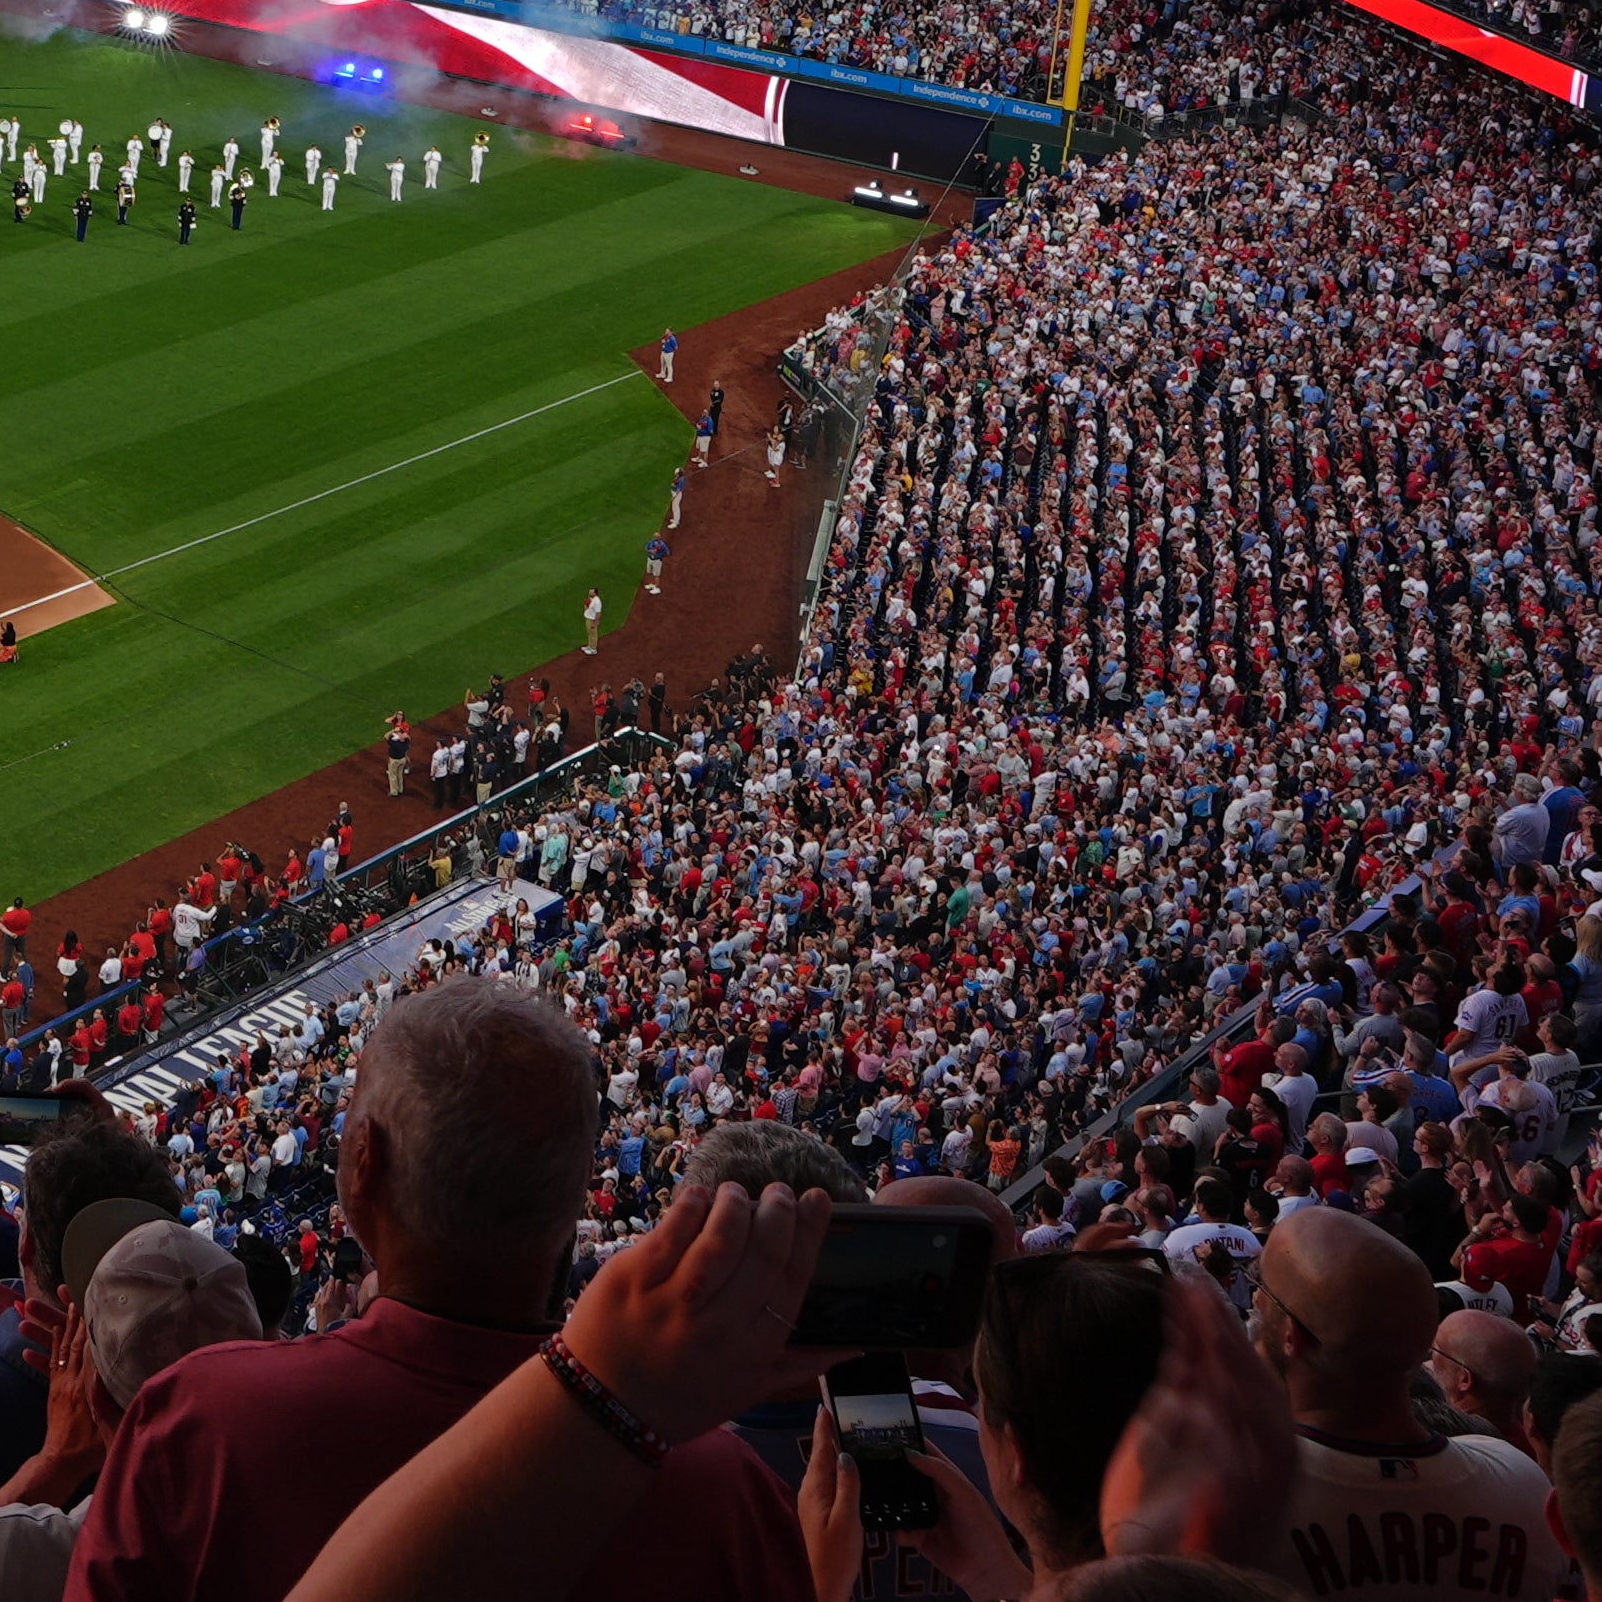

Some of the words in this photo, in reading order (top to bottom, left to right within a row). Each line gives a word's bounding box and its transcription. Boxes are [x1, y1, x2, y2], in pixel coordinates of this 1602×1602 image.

[640, 31, 674, 46] ibx.com
[716, 44, 776, 66] Independence
[830, 68, 868, 85] ibx.com
[912, 83, 978, 107] Independence
[1012, 104, 1053, 121] ibx.com
[1027, 143, 1042, 188] 33
[178, 913, 189, 925] 31
[1496, 1014, 1516, 1039] 61
[1248, 1169, 1259, 1189] 6
[1291, 1511, 1528, 1597] HARPER
